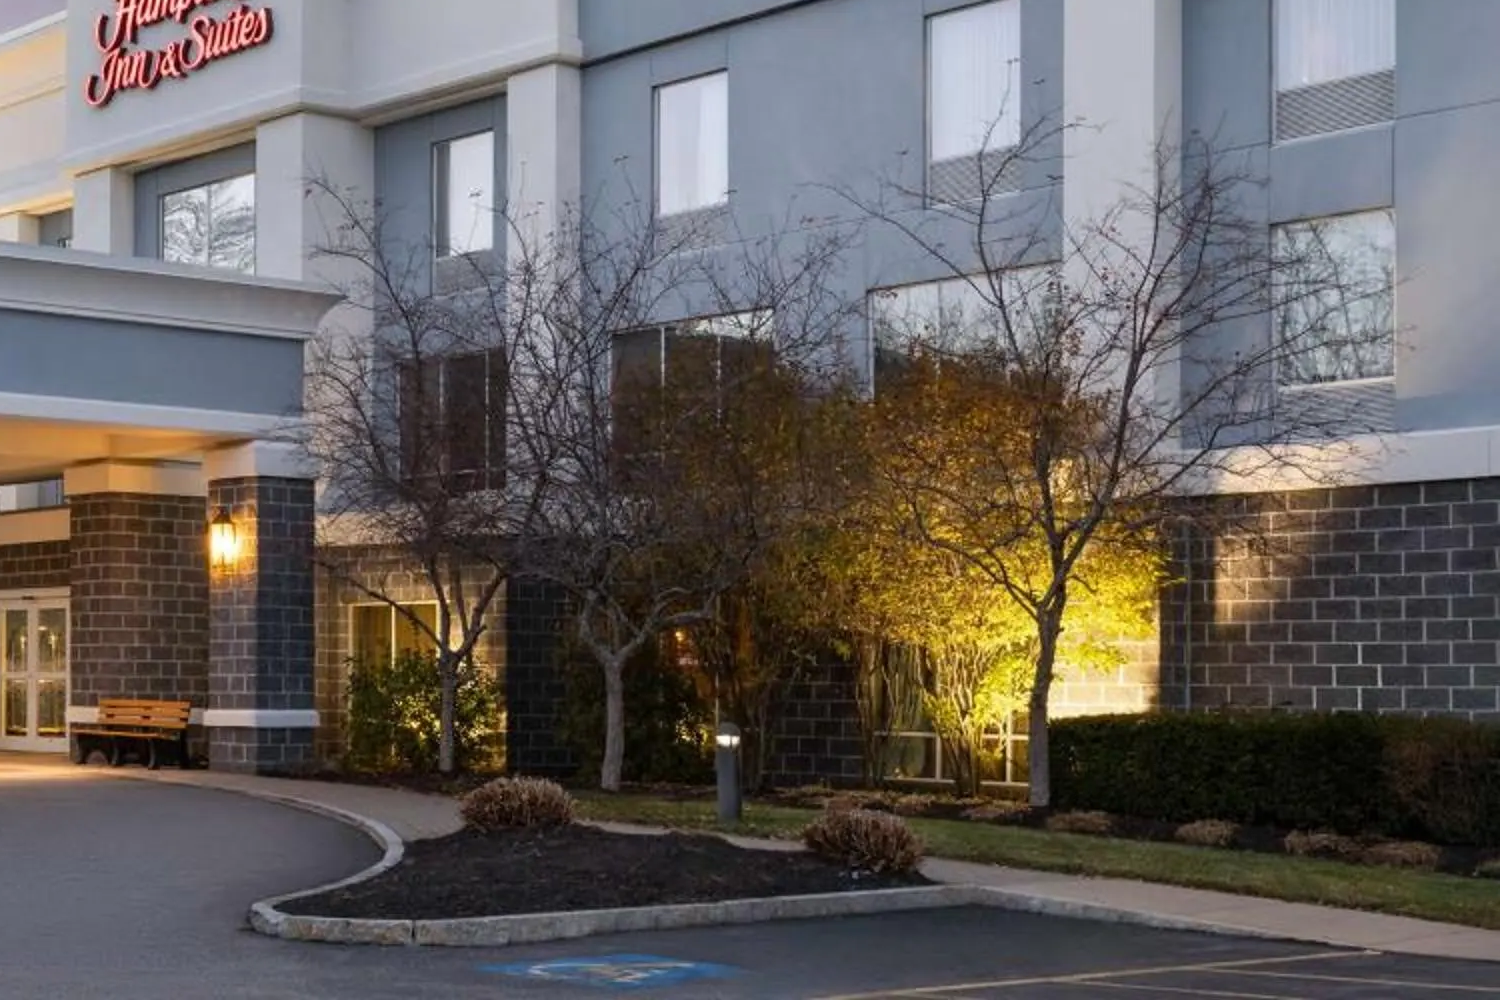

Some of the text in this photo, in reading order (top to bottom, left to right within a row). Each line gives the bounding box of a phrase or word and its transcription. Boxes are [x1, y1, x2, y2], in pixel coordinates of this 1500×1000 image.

[85, 4, 273, 107] Inn & Suites
